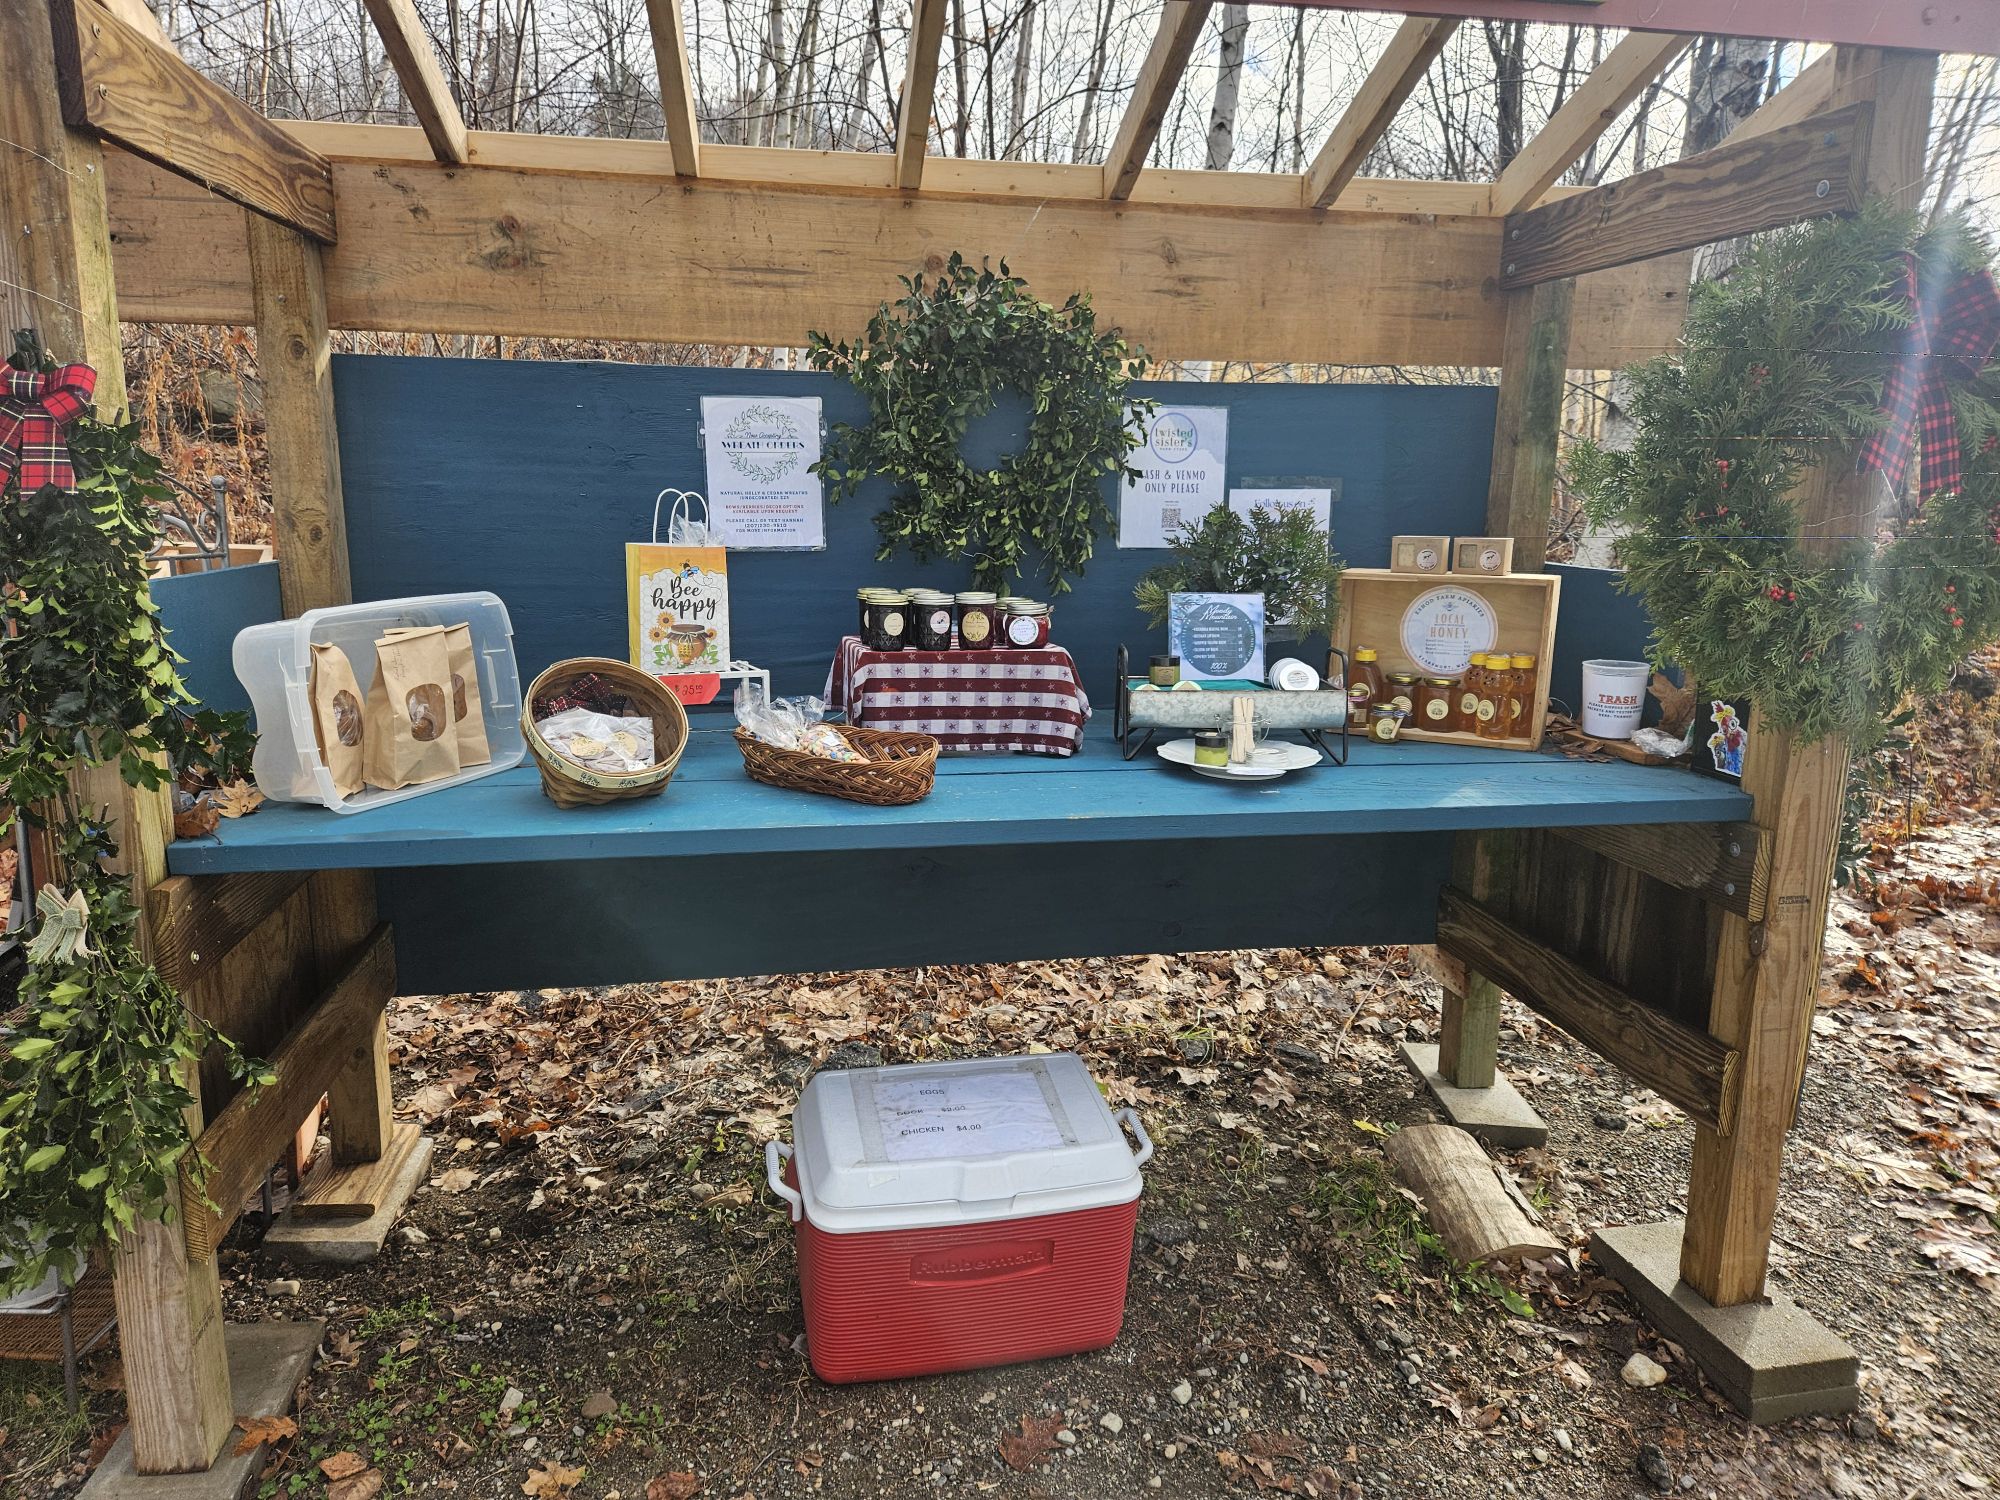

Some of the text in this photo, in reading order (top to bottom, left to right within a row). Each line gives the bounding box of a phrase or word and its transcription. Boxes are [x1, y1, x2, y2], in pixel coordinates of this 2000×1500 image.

[1155, 428, 1193, 438] twisted
[1155, 438, 1192, 447] sister's
[1144, 470, 1206, 480] ASH & VENMO
[1145, 482, 1200, 494] ONLY PLEASE
[671, 576, 701, 598] Bee
[651, 588, 716, 620] happy
[1435, 614, 1464, 624] LOCAL
[1430, 626, 1468, 638] HONEY
[1598, 694, 1637, 705] TRASH
[901, 1124, 981, 1136] CHICKEN $4.00
